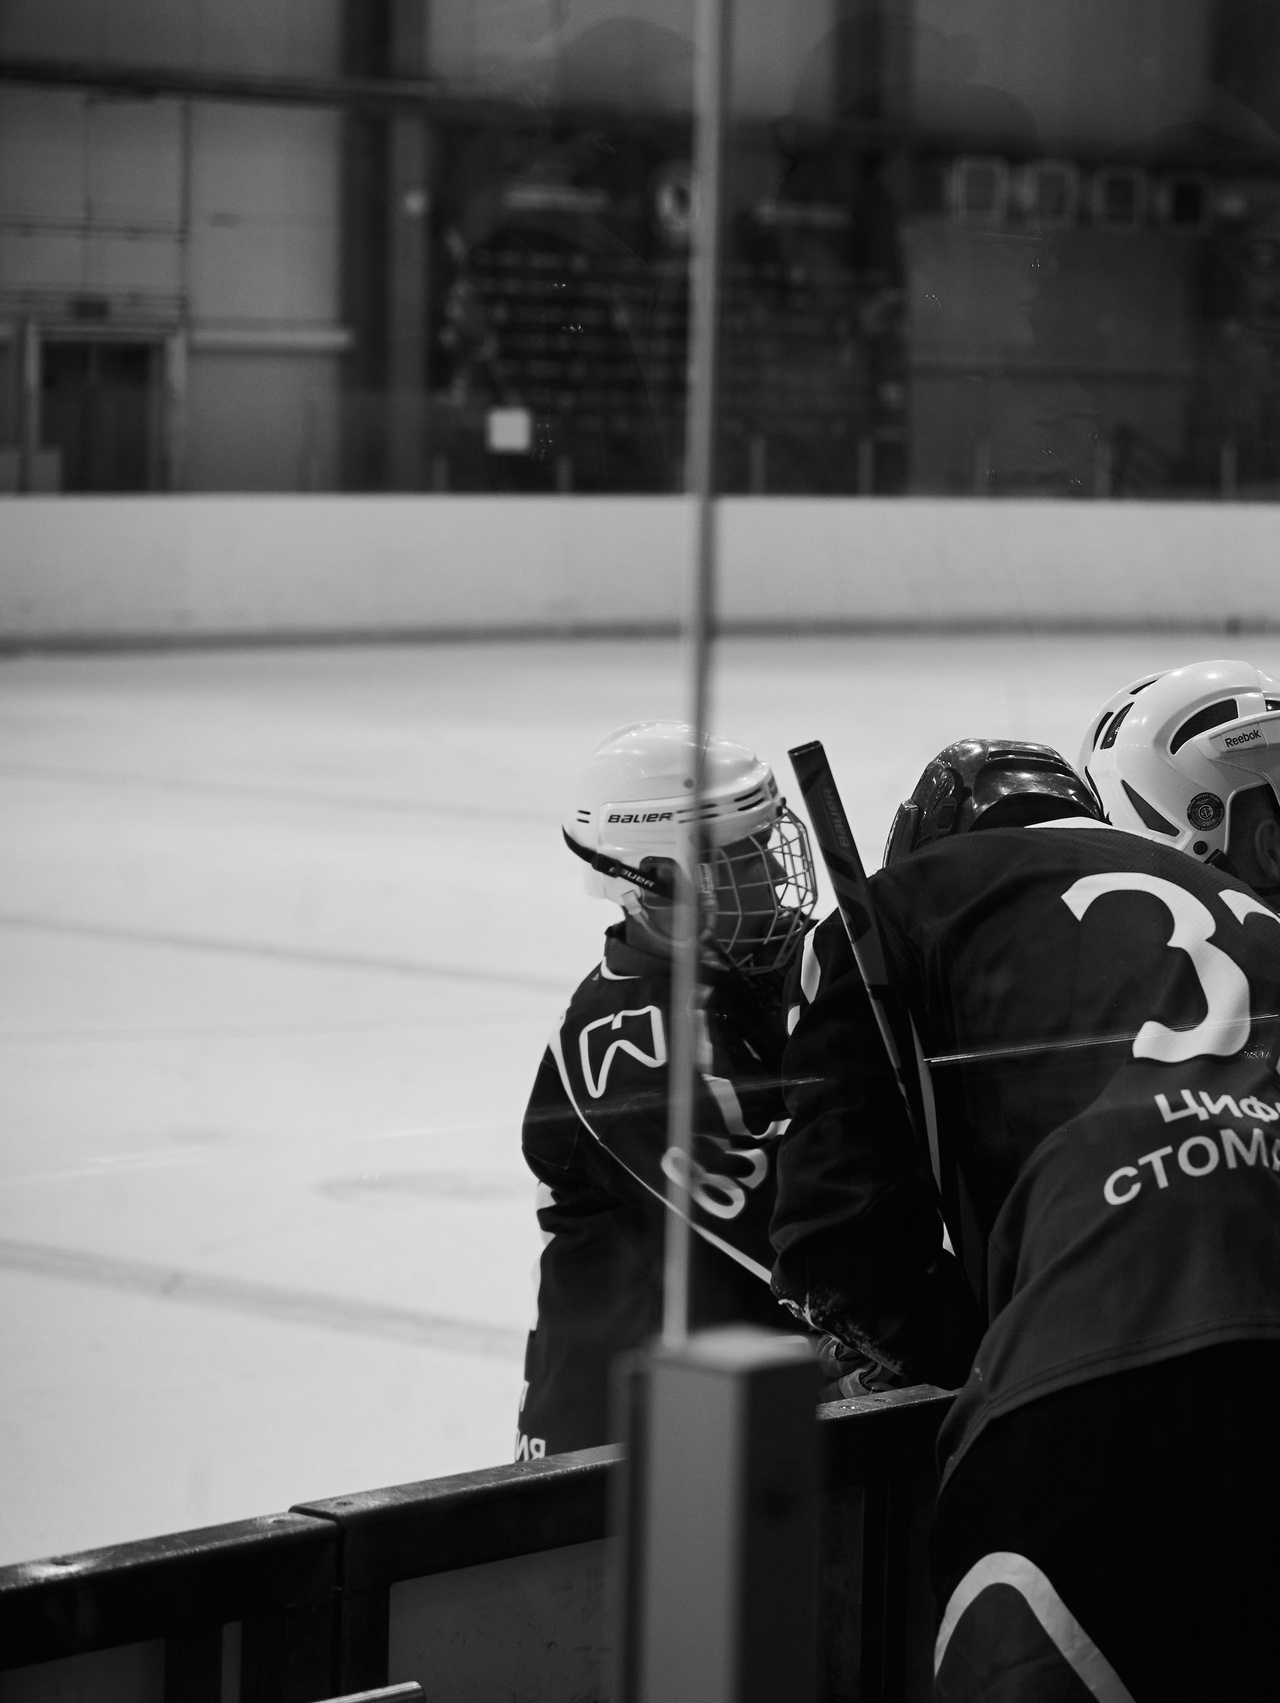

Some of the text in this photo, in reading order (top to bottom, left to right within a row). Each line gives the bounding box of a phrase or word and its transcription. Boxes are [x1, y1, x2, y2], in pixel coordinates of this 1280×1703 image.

[1223, 727, 1262, 749] Reebok
[607, 812, 673, 824] BAUER
[823, 787, 851, 848] BAUER
